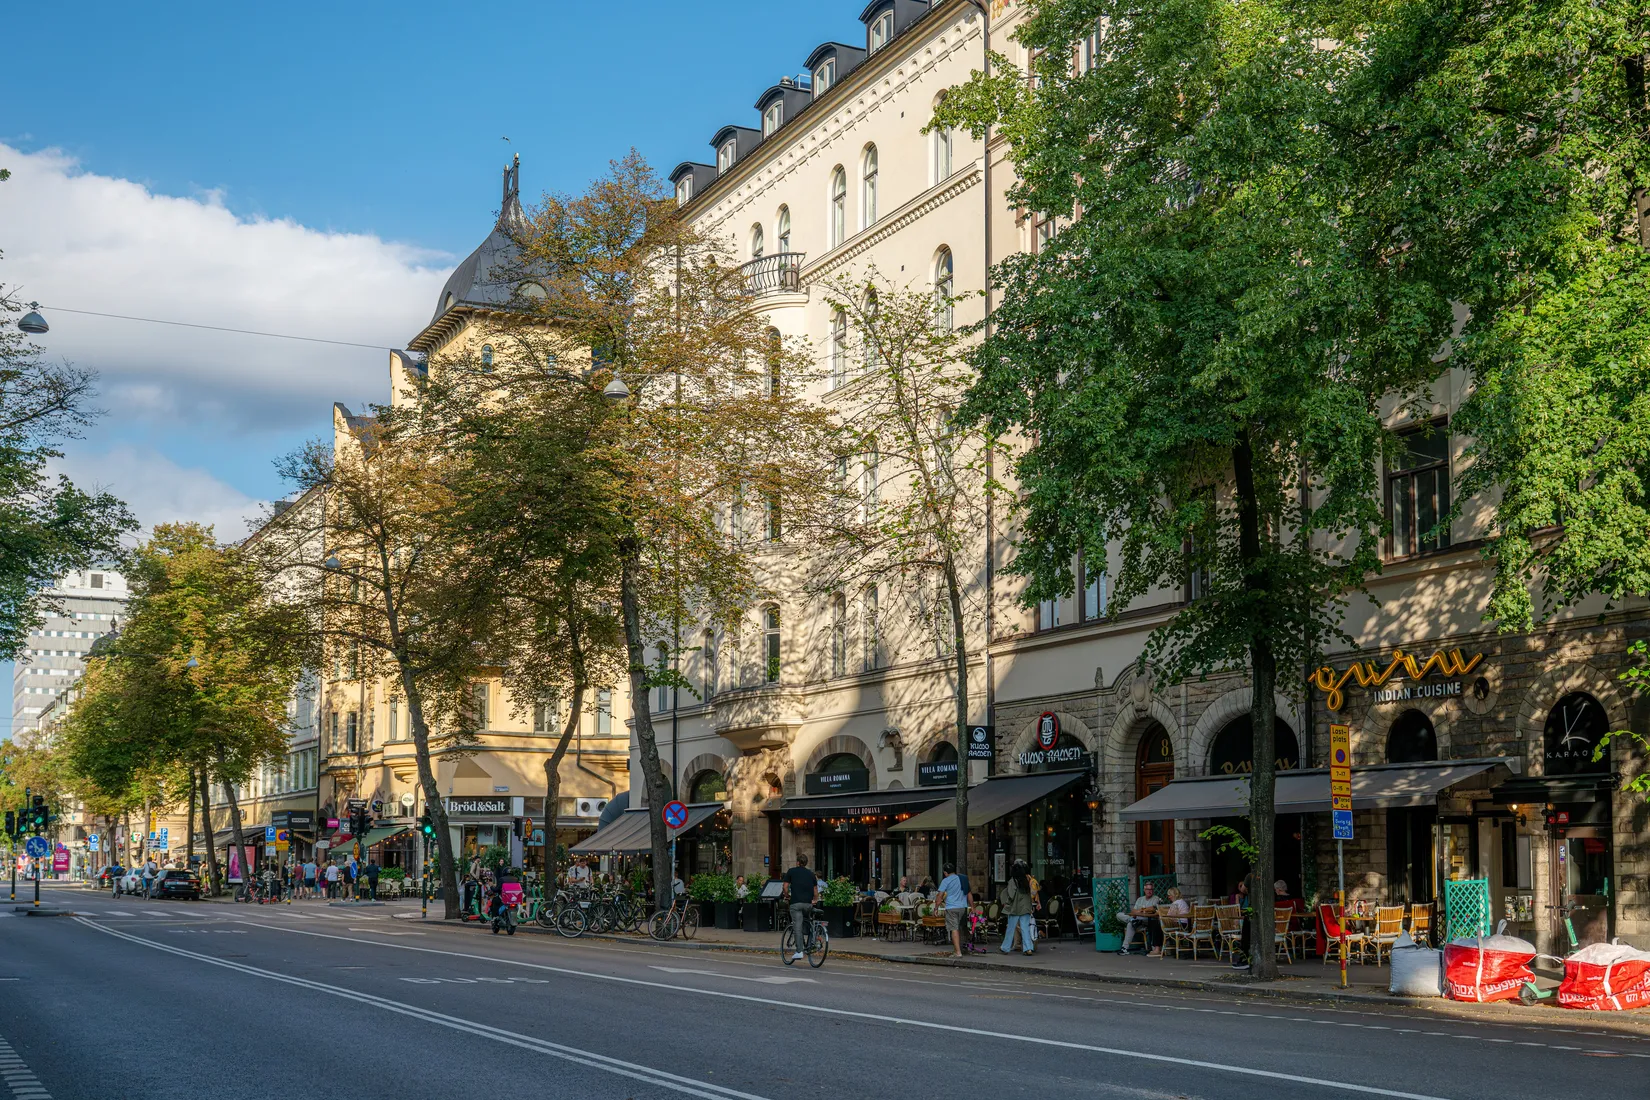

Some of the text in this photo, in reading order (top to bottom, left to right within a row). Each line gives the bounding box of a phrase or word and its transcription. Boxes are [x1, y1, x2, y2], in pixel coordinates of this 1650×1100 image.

[1308, 648, 1483, 711] guru
[1374, 682, 1461, 702] INDIAN CUISINE
[1047, 746, 1081, 763] RAMEN
[921, 764, 958, 774] VILLA ROMANA
[820, 774, 851, 783] VILLA ROMANA
[450, 801, 506, 812] Bröd&Salt
[861, 807, 880, 815] ROMANA
[268, 827, 274, 836] P
